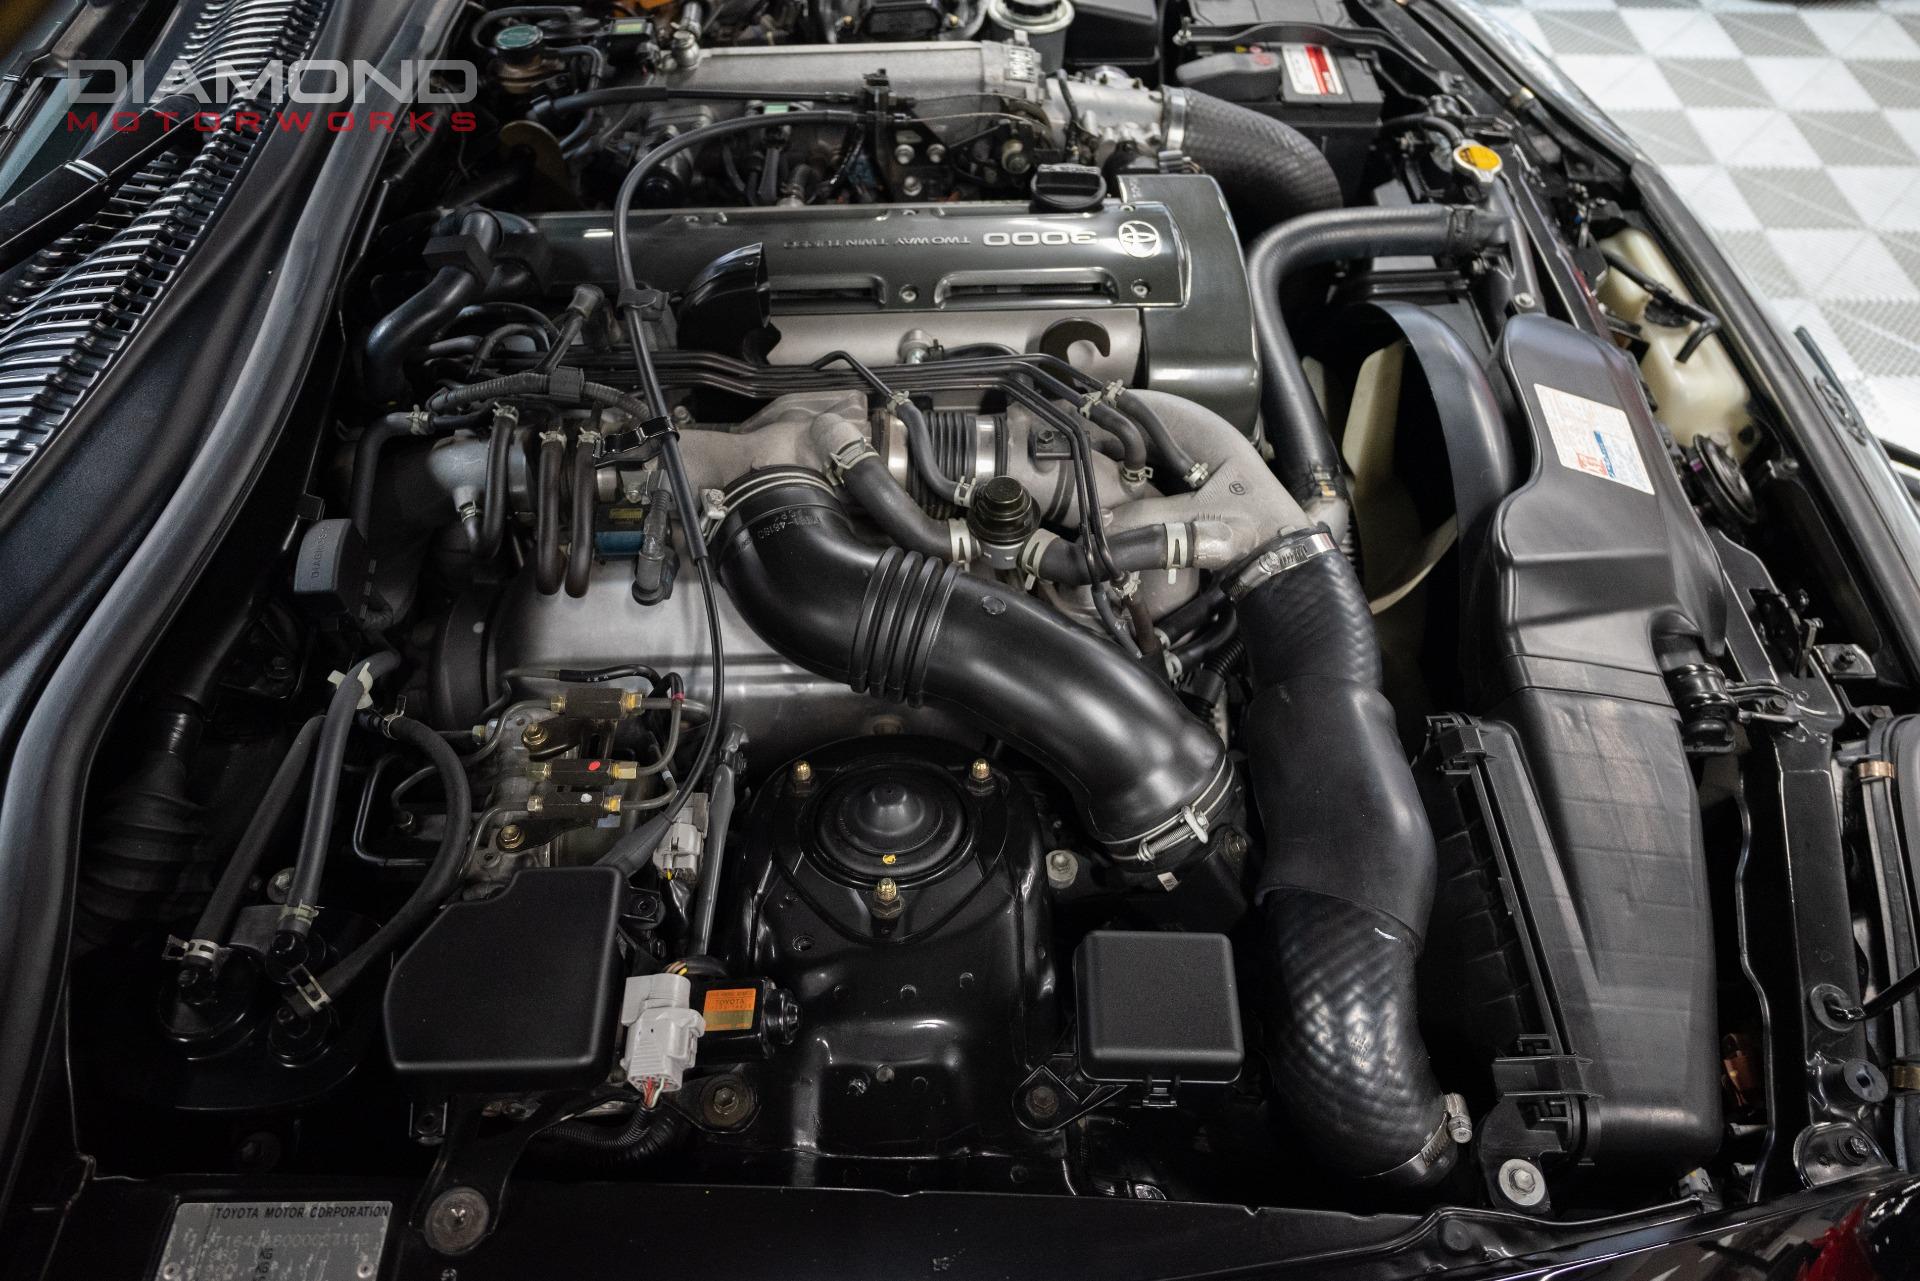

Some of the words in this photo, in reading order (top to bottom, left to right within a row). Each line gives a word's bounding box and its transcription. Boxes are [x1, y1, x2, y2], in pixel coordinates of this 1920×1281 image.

[845, 237, 888, 247] TWIN
[983, 231, 1097, 247] 3000
[215, 1207, 258, 1219] TOYOTA
[264, 1206, 305, 1218] MOTOR
[309, 1205, 391, 1217] CORPORATION
